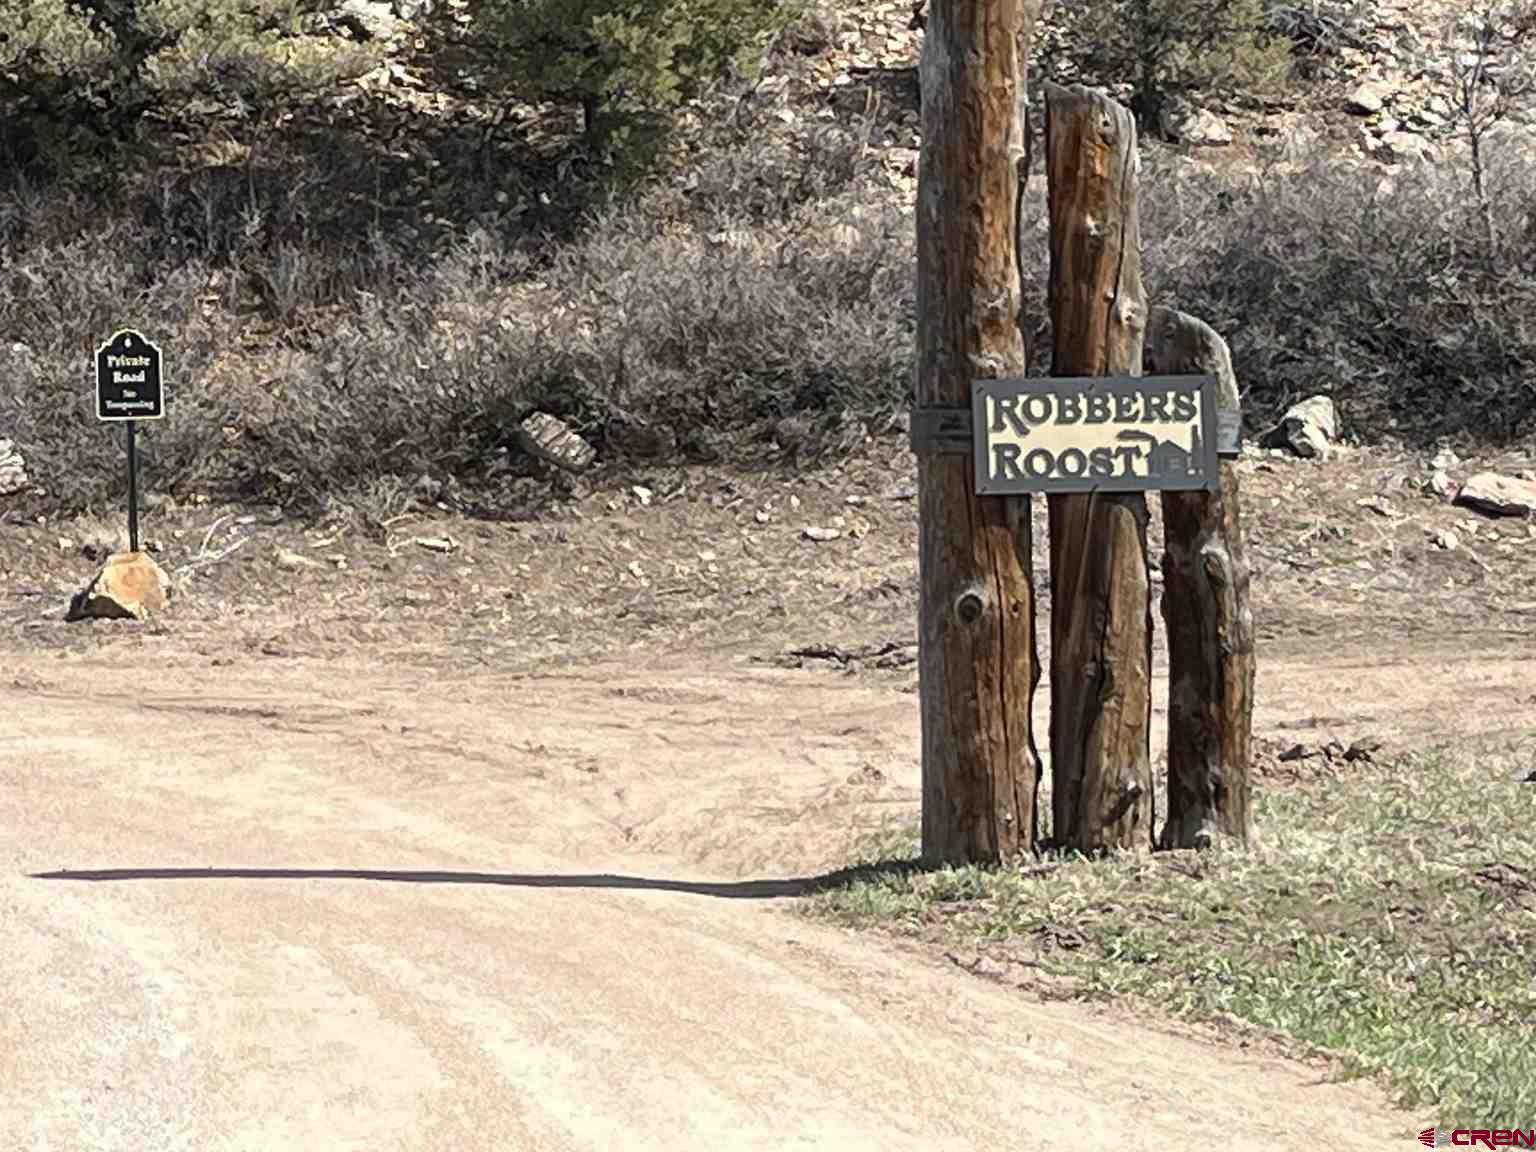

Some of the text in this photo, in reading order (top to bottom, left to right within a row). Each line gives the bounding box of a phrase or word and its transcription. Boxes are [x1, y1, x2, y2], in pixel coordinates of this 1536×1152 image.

[107, 354, 150, 367] Private
[113, 370, 145, 383] Road
[989, 391, 1199, 436] ROBBERS
[992, 442, 1146, 479] ROOST
